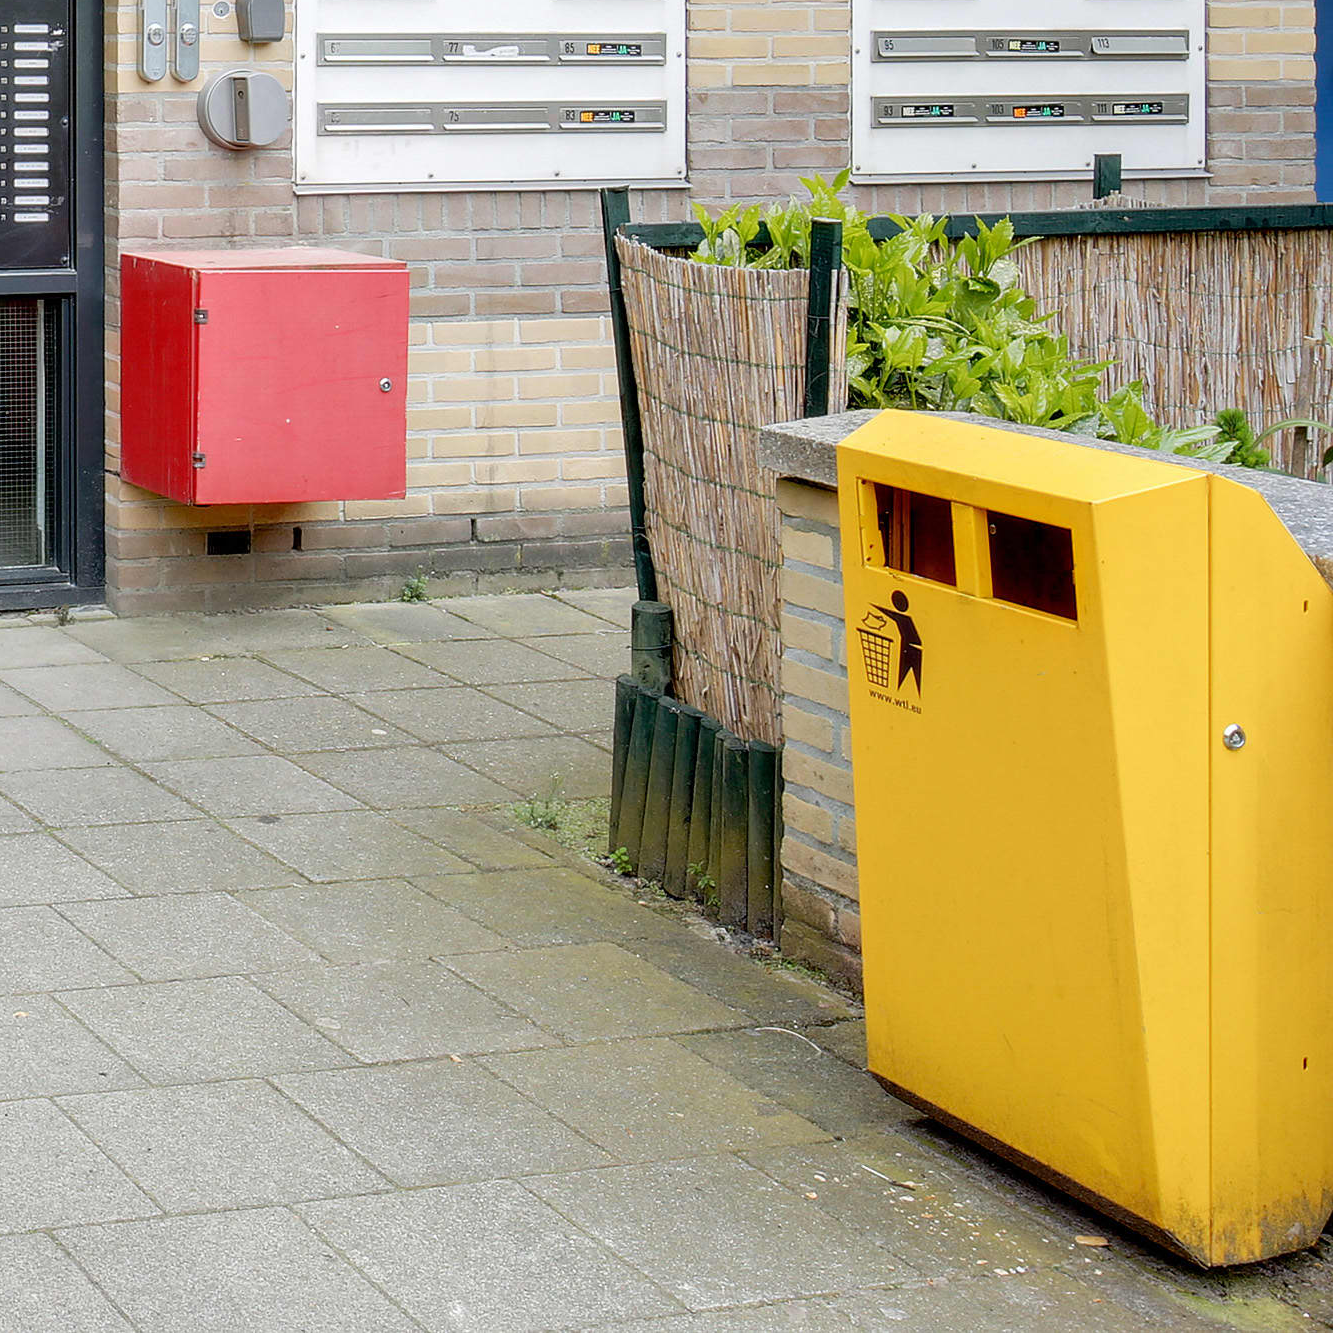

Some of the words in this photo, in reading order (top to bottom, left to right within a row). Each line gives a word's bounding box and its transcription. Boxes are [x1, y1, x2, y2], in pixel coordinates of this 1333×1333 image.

[448, 43, 458, 53] 77
[884, 40, 894, 50] 95
[1098, 38, 1109, 48] 113
[564, 44, 575, 54] 85
[1096, 103, 1107, 113] 111
[449, 111, 460, 122] 75
